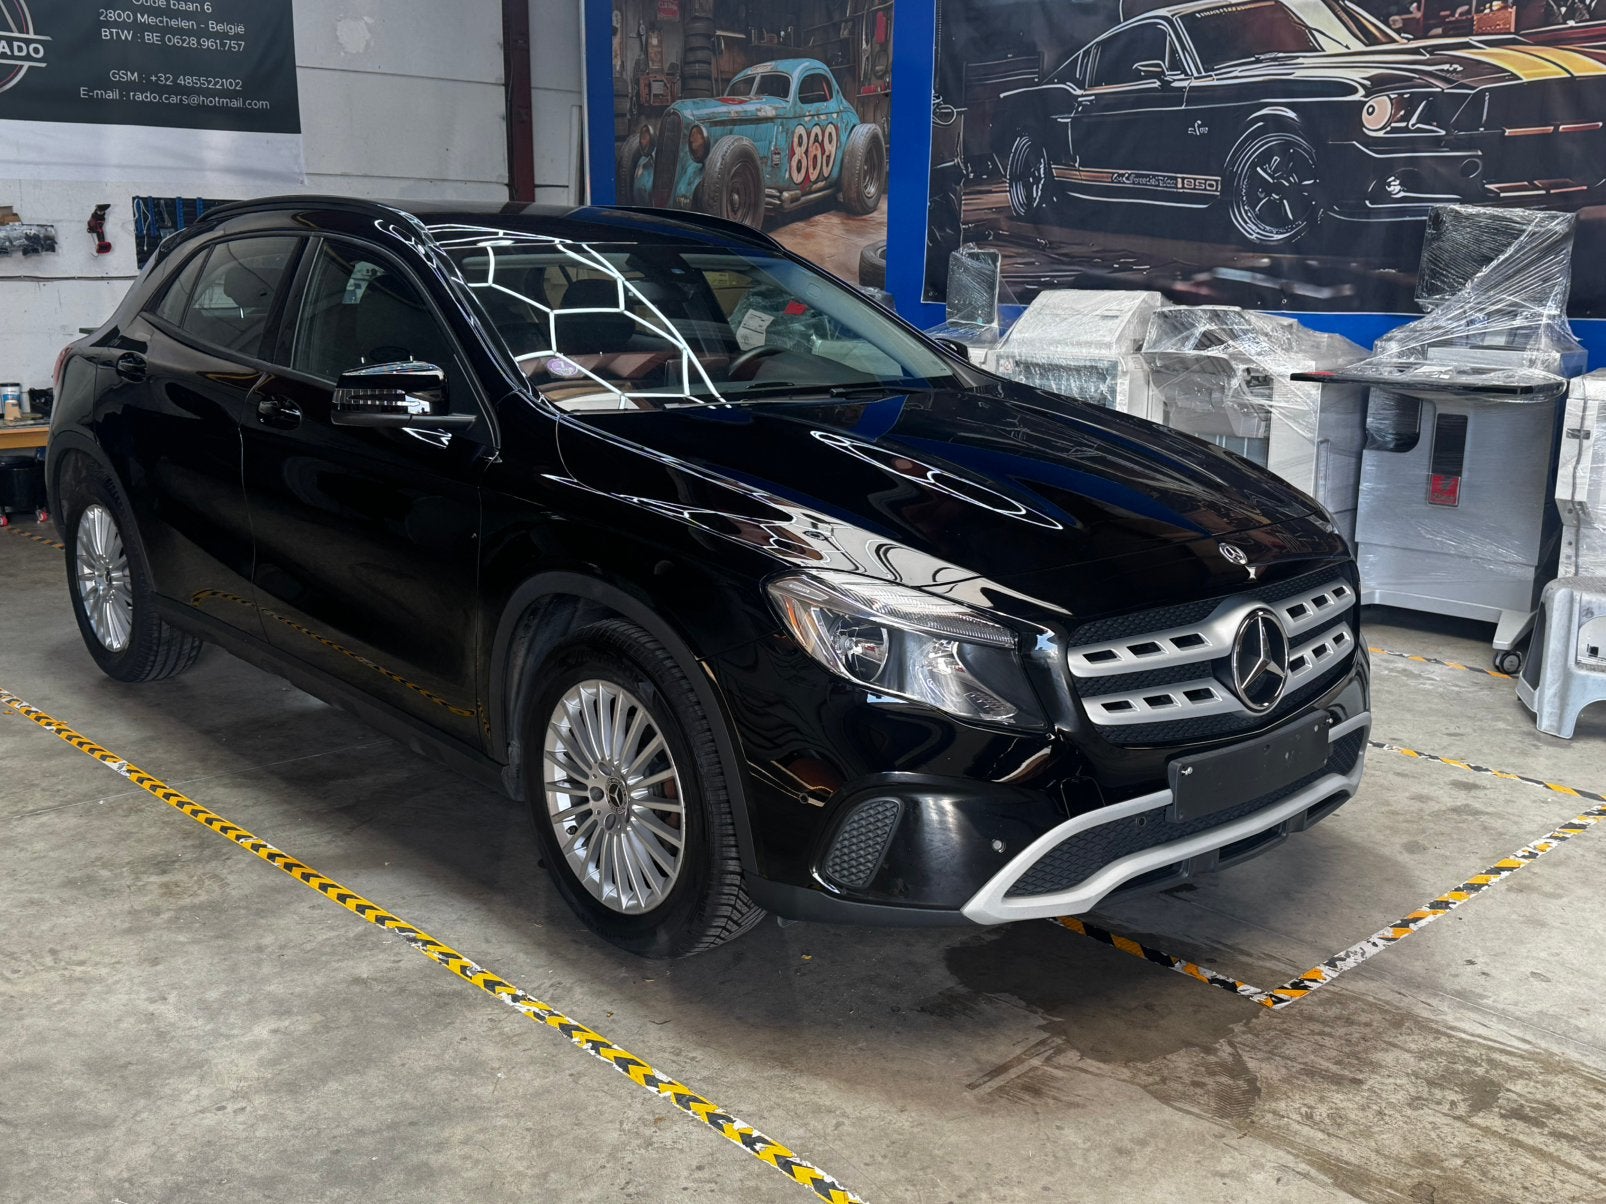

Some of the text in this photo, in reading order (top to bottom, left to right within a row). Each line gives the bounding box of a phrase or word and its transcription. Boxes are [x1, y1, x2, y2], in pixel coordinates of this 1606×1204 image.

[170, 0, 200, 12] baan
[204, 2, 212, 13] 6
[99, 9, 133, 22] 2800
[137, 12, 197, 29] Mechelen
[208, 20, 245, 35] België
[101, 28, 133, 41] BTW
[144, 32, 162, 44] BE
[165, 34, 245, 51] 0628.961.757
[109, 69, 139, 82] GSM
[150, 73, 173, 85] +32
[177, 75, 242, 90] 485522102
[80, 86, 120, 100] E-mail
[130, 91, 270, 110] rado.cars@hotmail.com
[790, 123, 837, 185] 869
